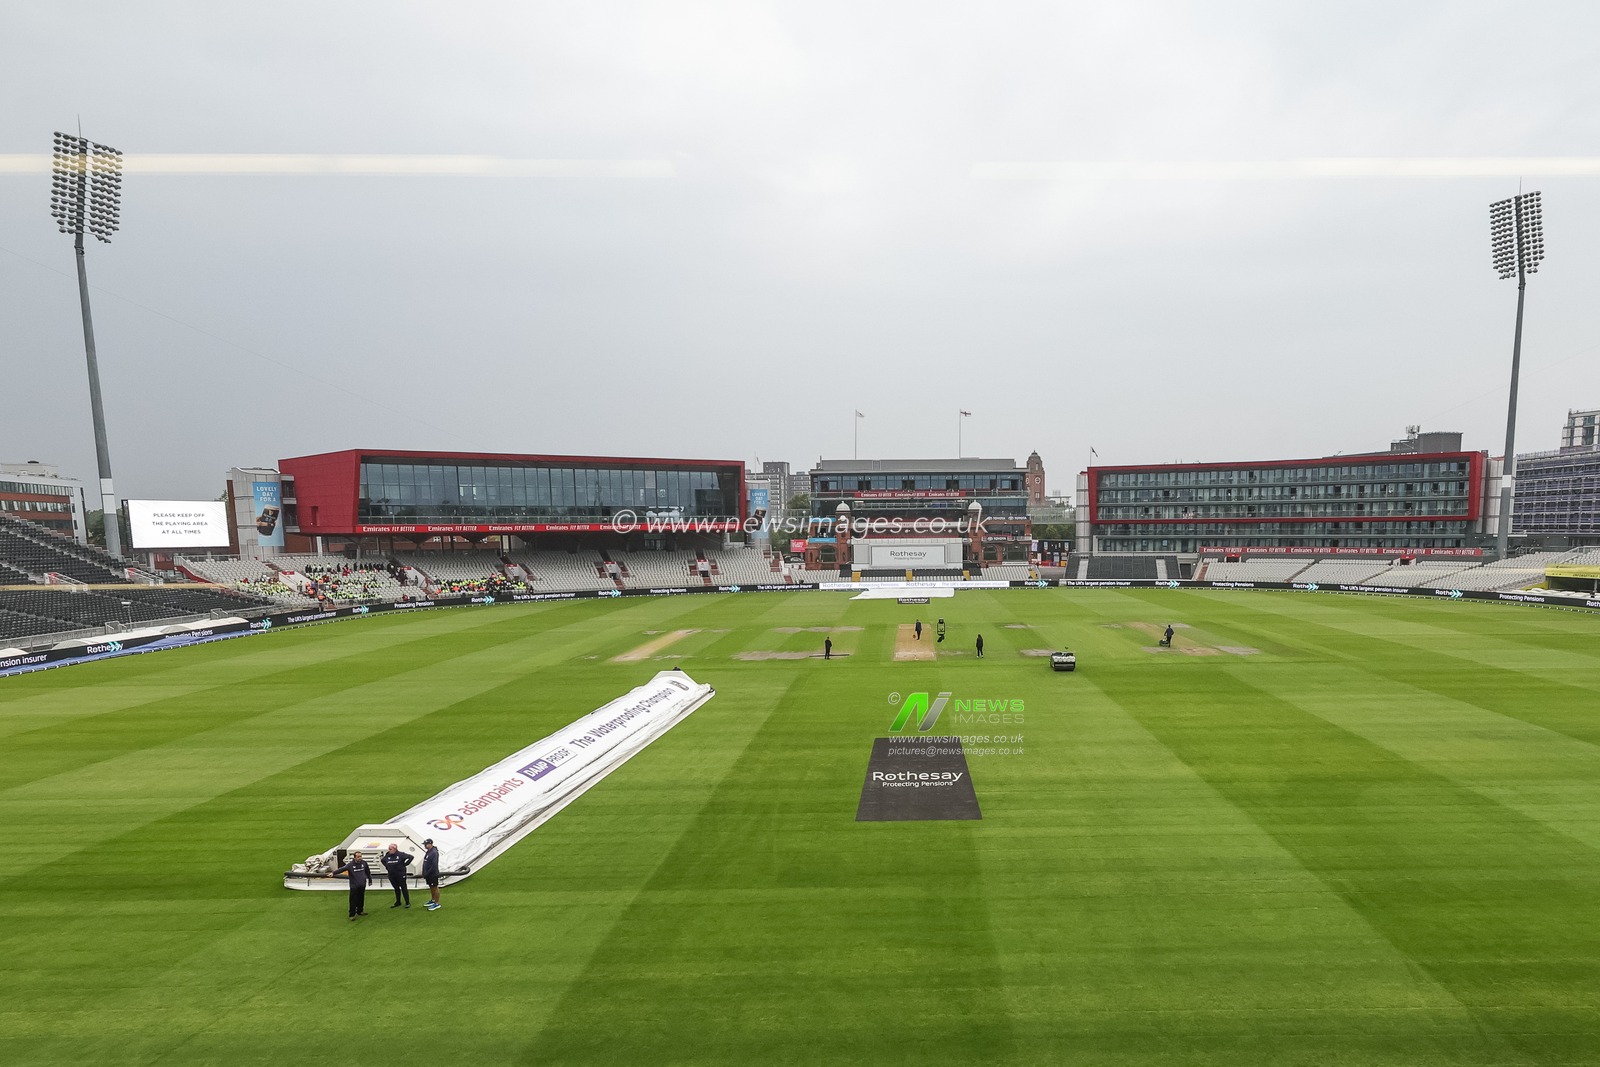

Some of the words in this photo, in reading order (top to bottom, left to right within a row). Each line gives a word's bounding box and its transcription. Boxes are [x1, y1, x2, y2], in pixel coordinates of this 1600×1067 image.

[250, 620, 272, 628] Rothey
[87, 642, 123, 654] Rothey
[22, 655, 47, 664] insurer
[458, 778, 524, 816] asianpaints
[523, 760, 549, 777] DAMP
[546, 748, 570, 764] PROOF
[569, 734, 595, 749] The
[587, 702, 650, 738] Waterproofing
[639, 687, 676, 710] Champion
[872, 771, 963, 782] Rothesay
